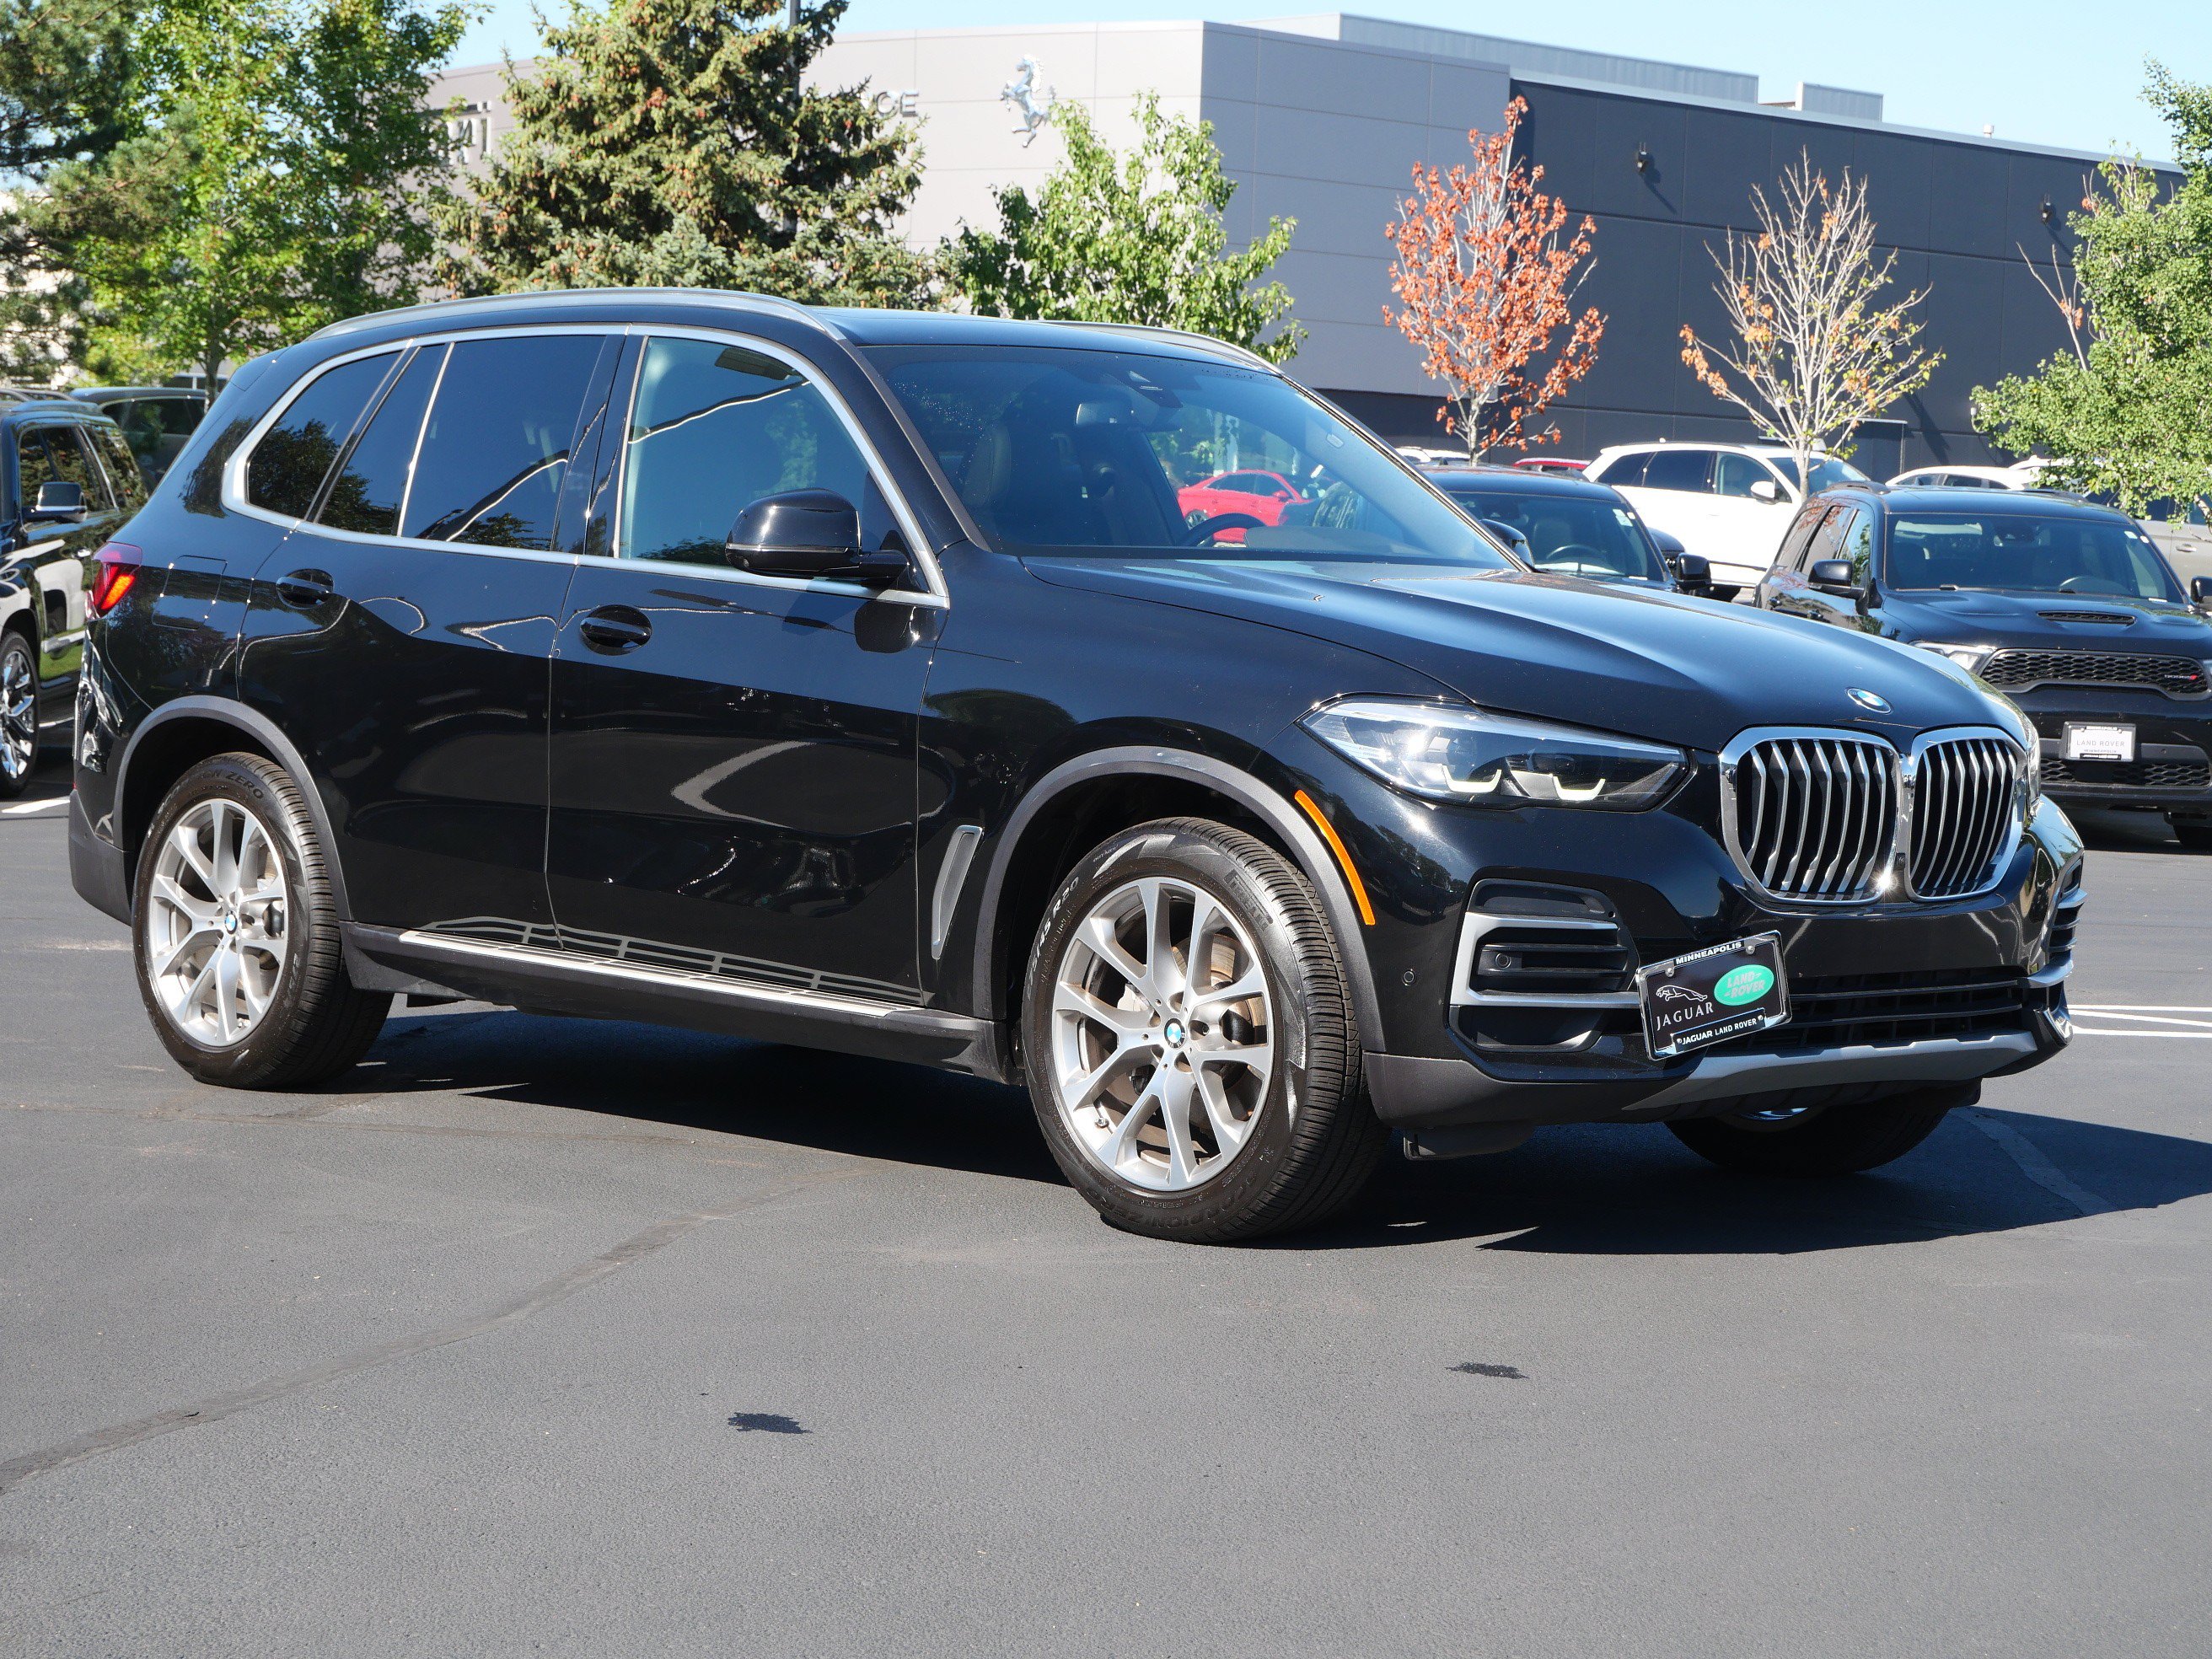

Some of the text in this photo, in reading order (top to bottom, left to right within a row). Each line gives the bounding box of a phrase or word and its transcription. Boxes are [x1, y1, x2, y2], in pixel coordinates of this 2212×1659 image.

[225, 770, 264, 799] ZERO
[1675, 942, 1742, 965] MINNEAPOLIS
[1656, 1001, 1715, 1031] JAGUAR
[1681, 1018, 1758, 1045] JAGUAR LAND ROVER
